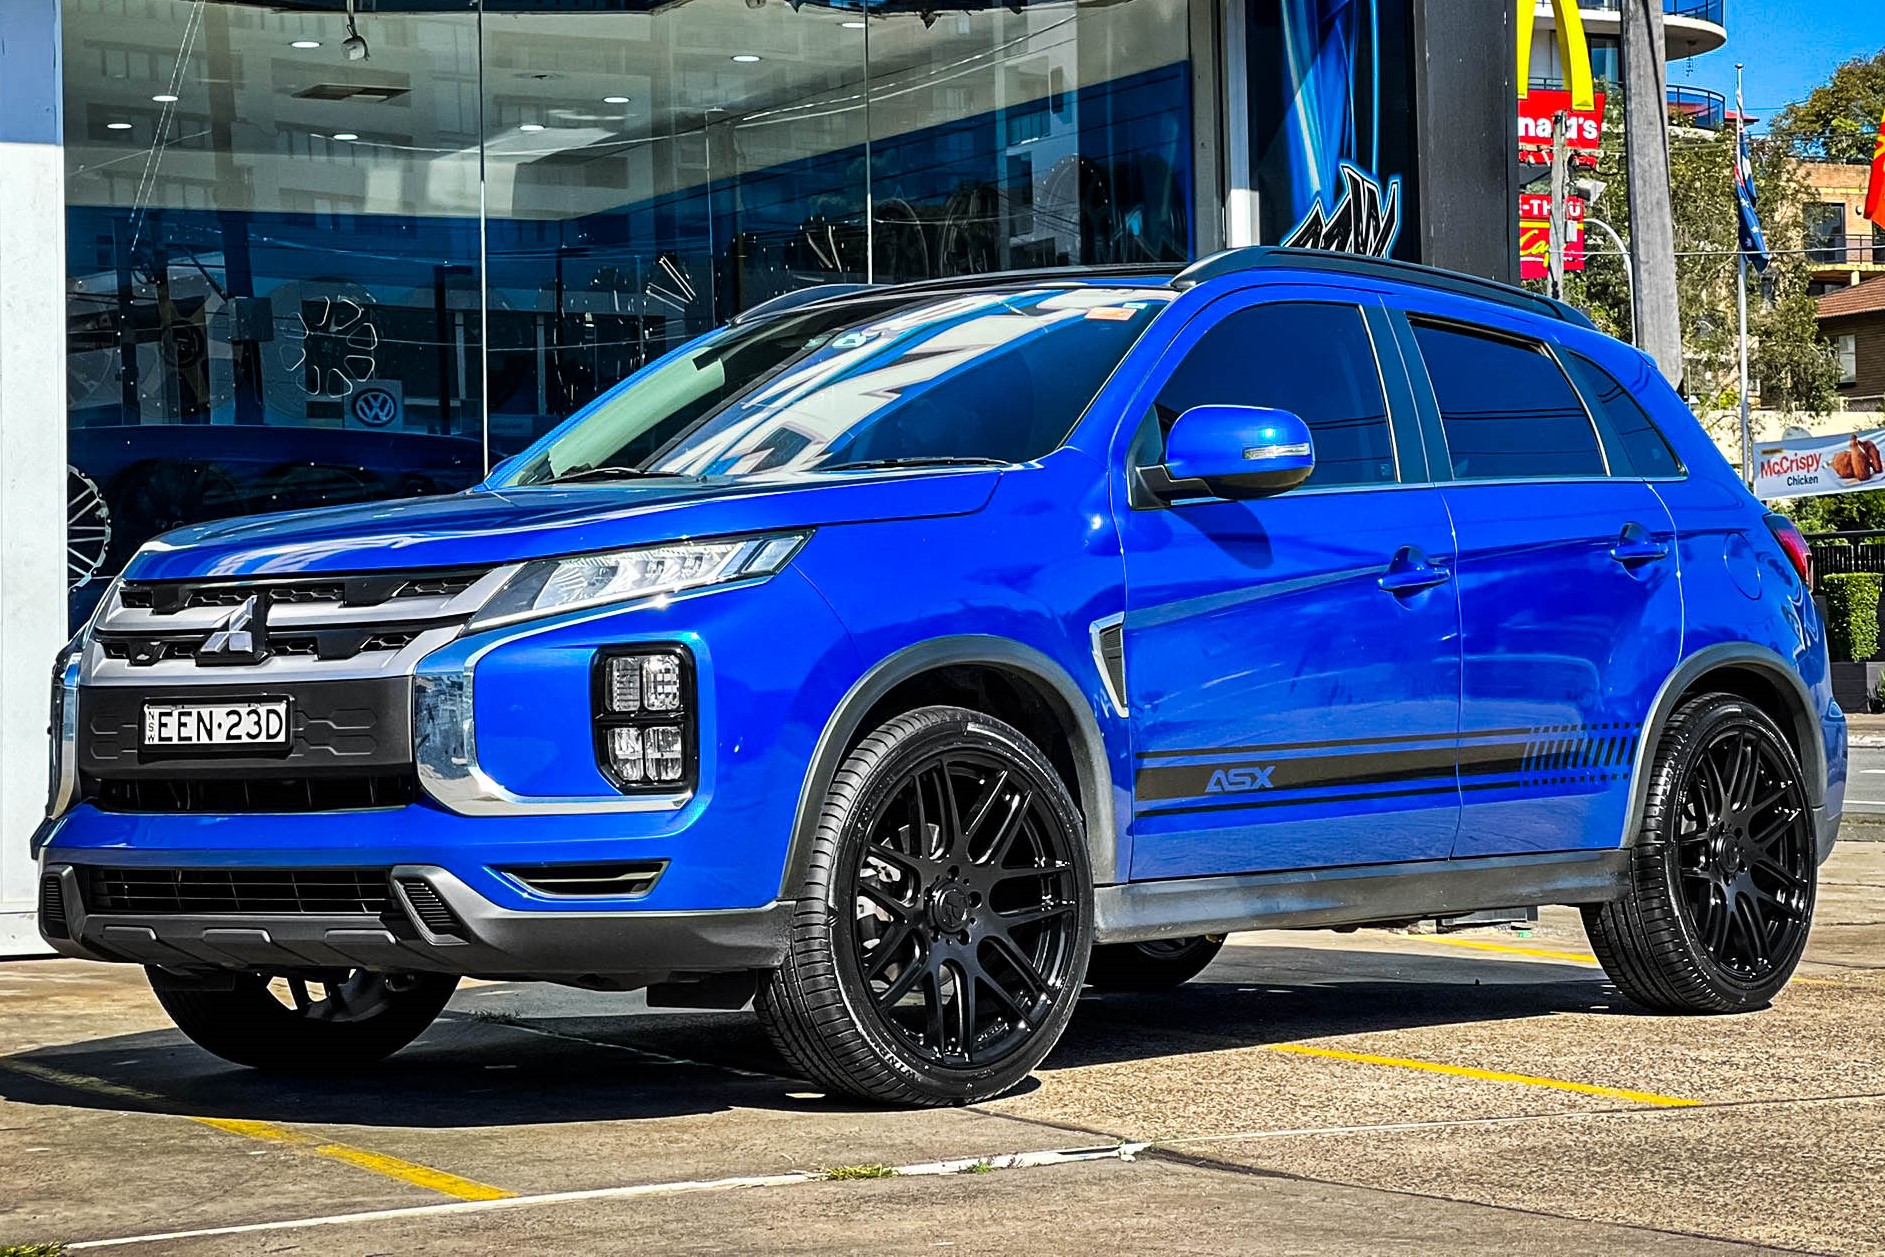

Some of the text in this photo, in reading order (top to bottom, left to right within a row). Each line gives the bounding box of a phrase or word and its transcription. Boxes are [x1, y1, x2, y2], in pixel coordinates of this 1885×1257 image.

[1760, 452, 1822, 479] McCrispy
[1787, 474, 1819, 487] Chicken
[1204, 765, 1276, 793] ASX
